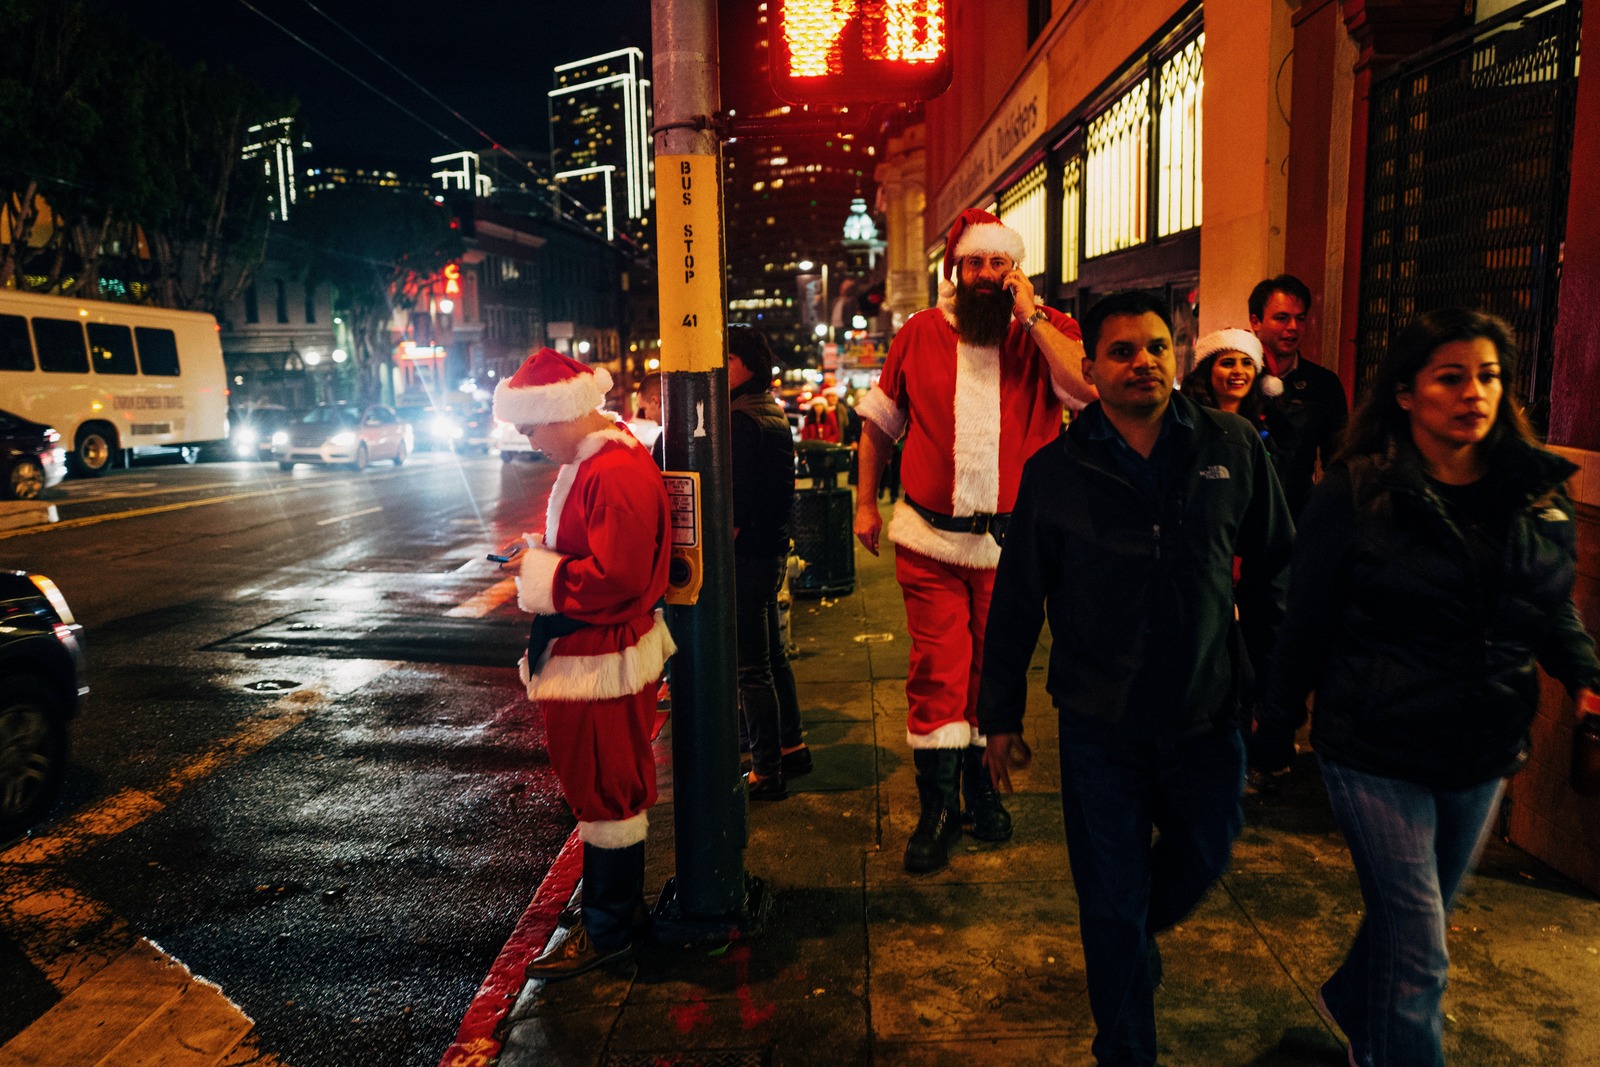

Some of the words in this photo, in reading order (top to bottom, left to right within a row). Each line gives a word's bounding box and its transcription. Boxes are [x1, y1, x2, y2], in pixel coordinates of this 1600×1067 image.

[680, 161, 692, 206] BUS
[683, 224, 695, 284] STOP
[682, 314, 698, 328] 41
